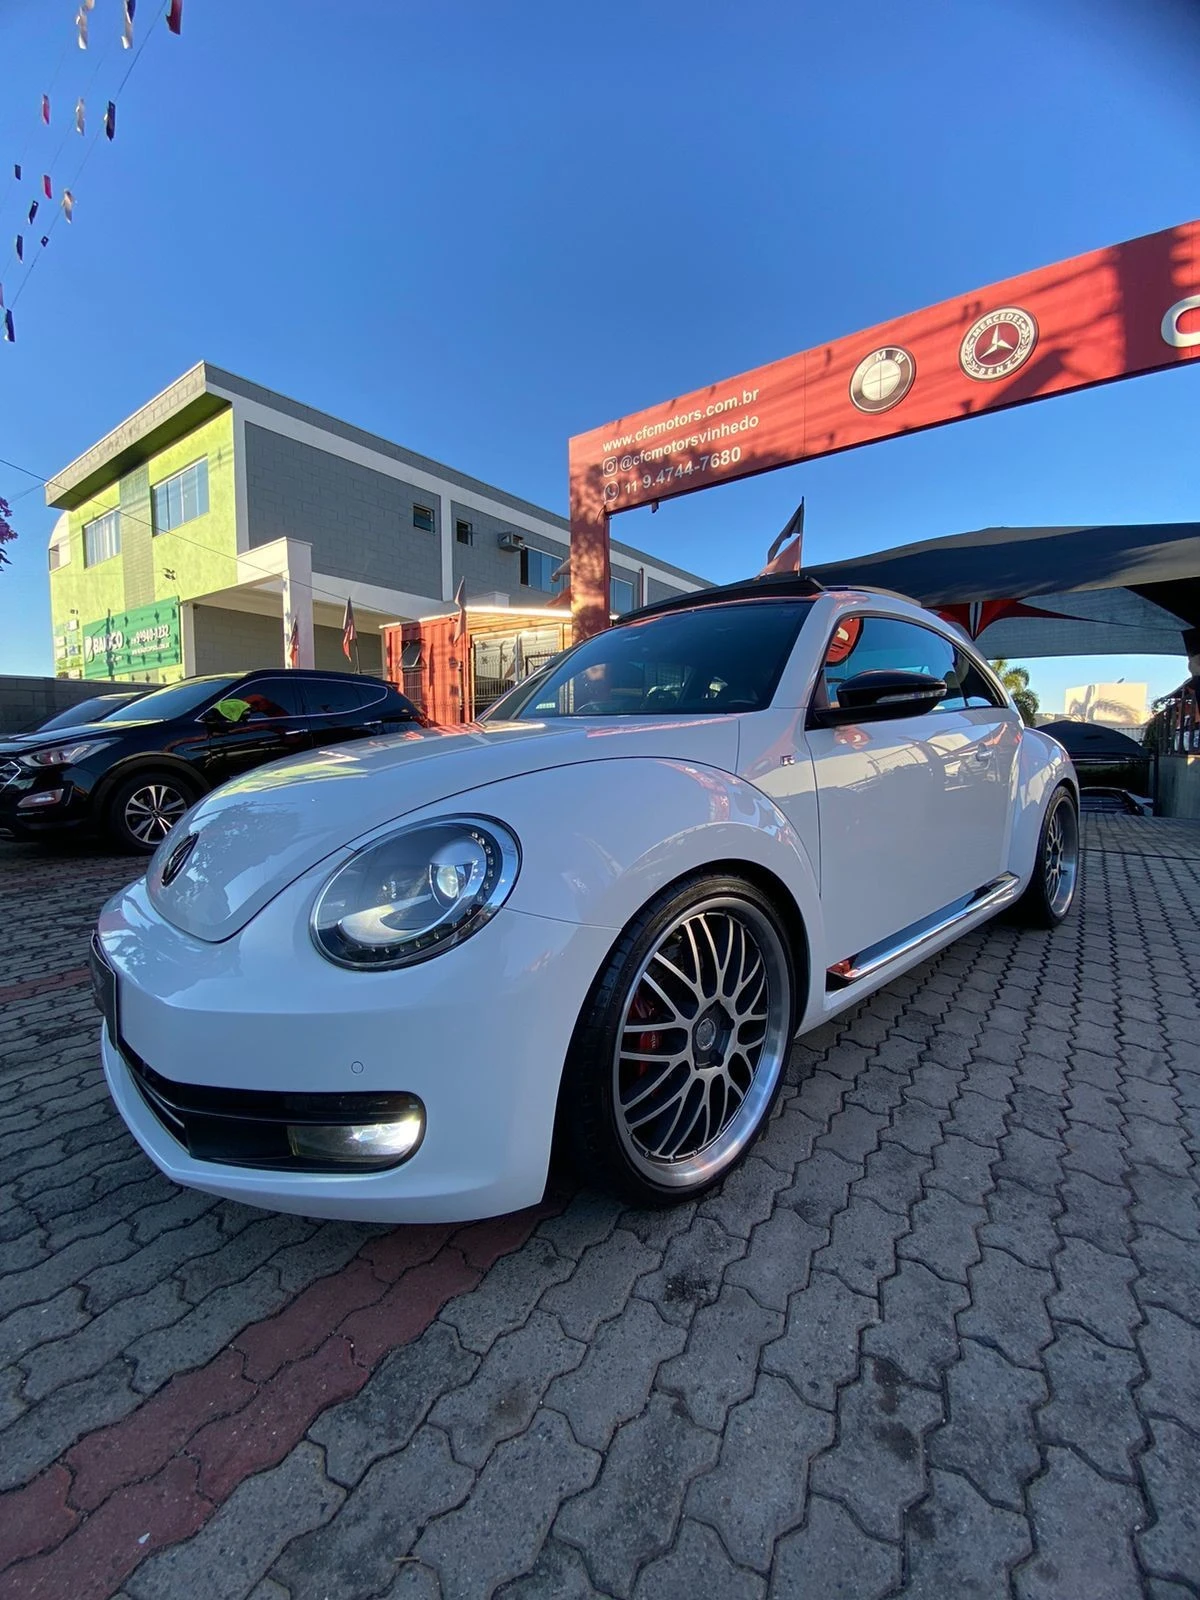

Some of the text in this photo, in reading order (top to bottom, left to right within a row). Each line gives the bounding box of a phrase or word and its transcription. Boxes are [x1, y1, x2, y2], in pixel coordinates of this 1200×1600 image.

[972, 313, 1024, 337] MERCEDES
[979, 360, 1012, 375] BENZ
[602, 388, 760, 452] www.cfcmotors.com.br
[620, 415, 759, 472] @cfcmotorsvinhedo
[625, 446, 742, 494] 11 9.4744-7680
